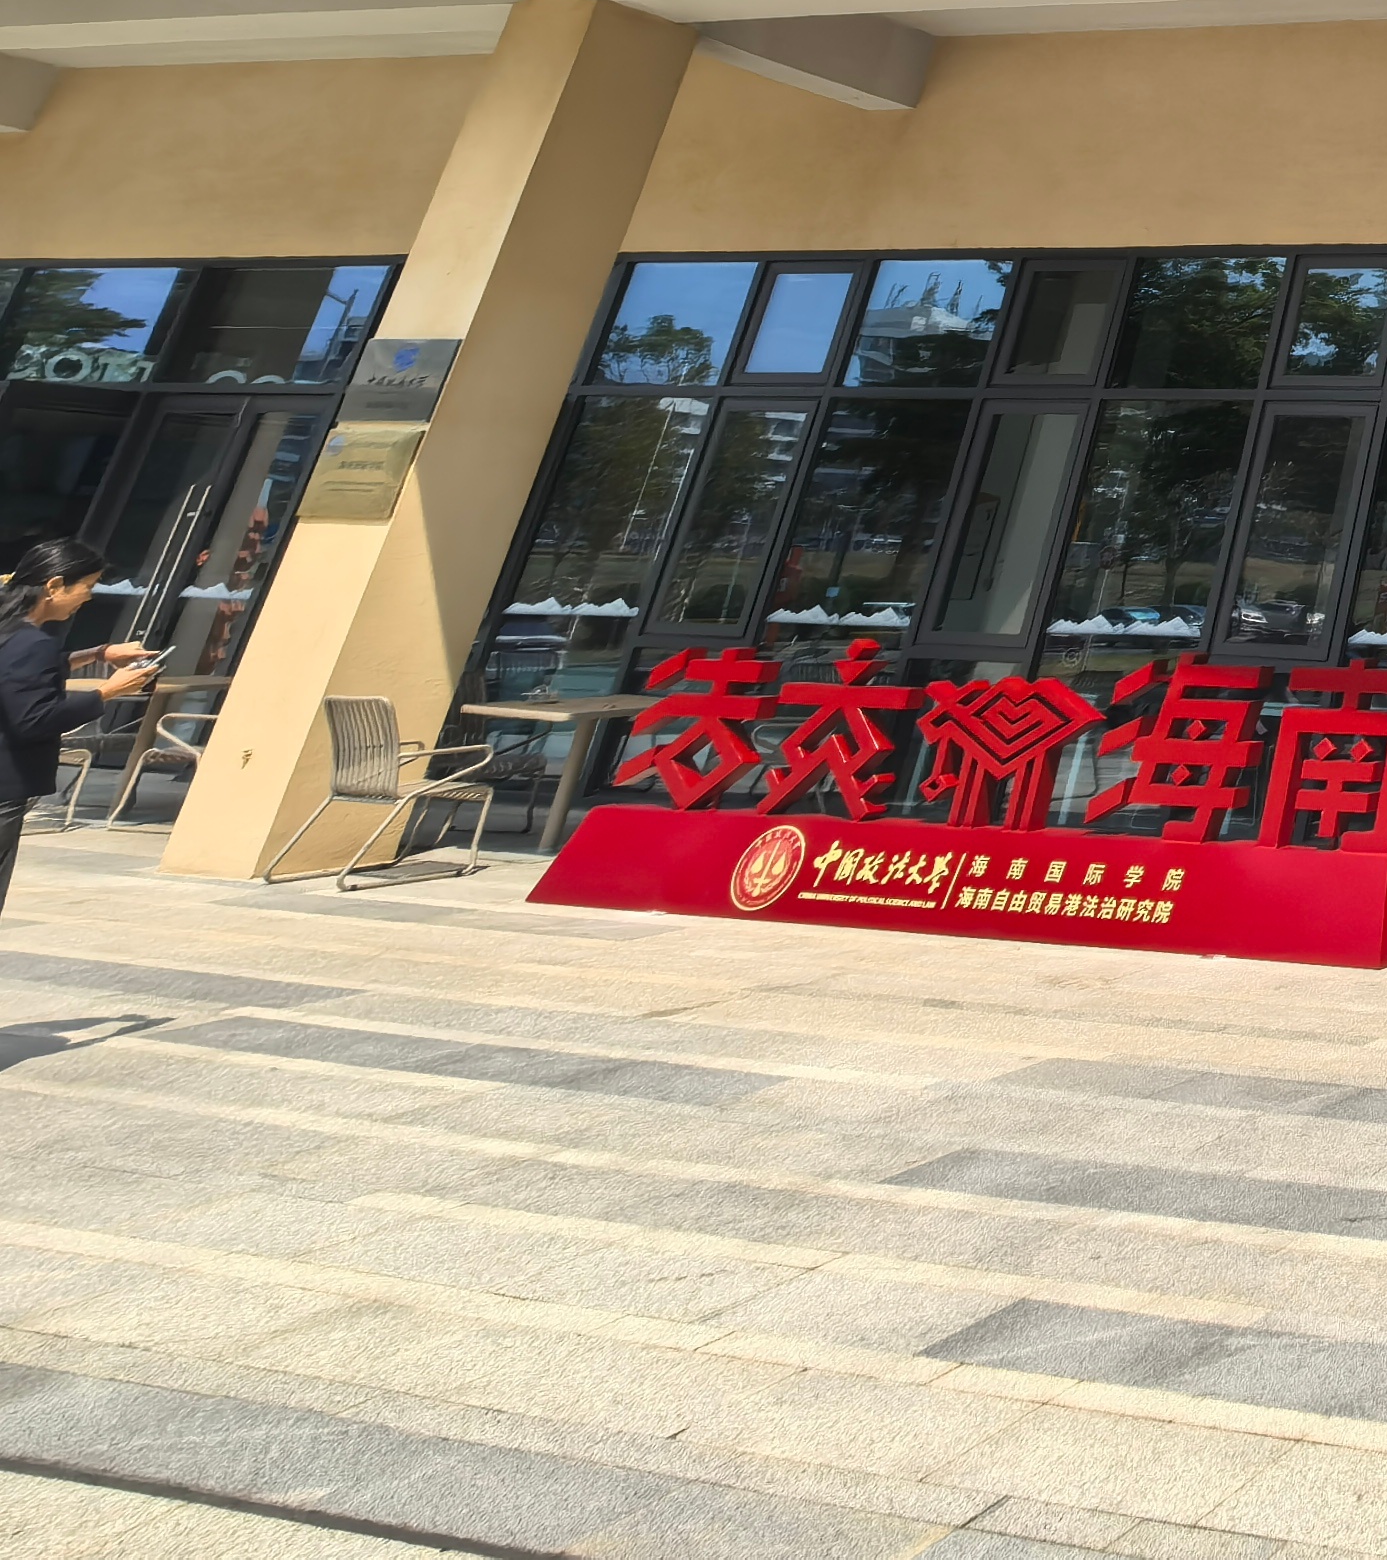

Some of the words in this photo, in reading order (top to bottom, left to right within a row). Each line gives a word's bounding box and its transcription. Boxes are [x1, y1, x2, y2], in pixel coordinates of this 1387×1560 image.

[813, 840, 953, 894] 中国政法大学
[968, 854, 1185, 891] 海南国际学院
[955, 885, 1174, 924] 海南自由贸易港法治研究院
